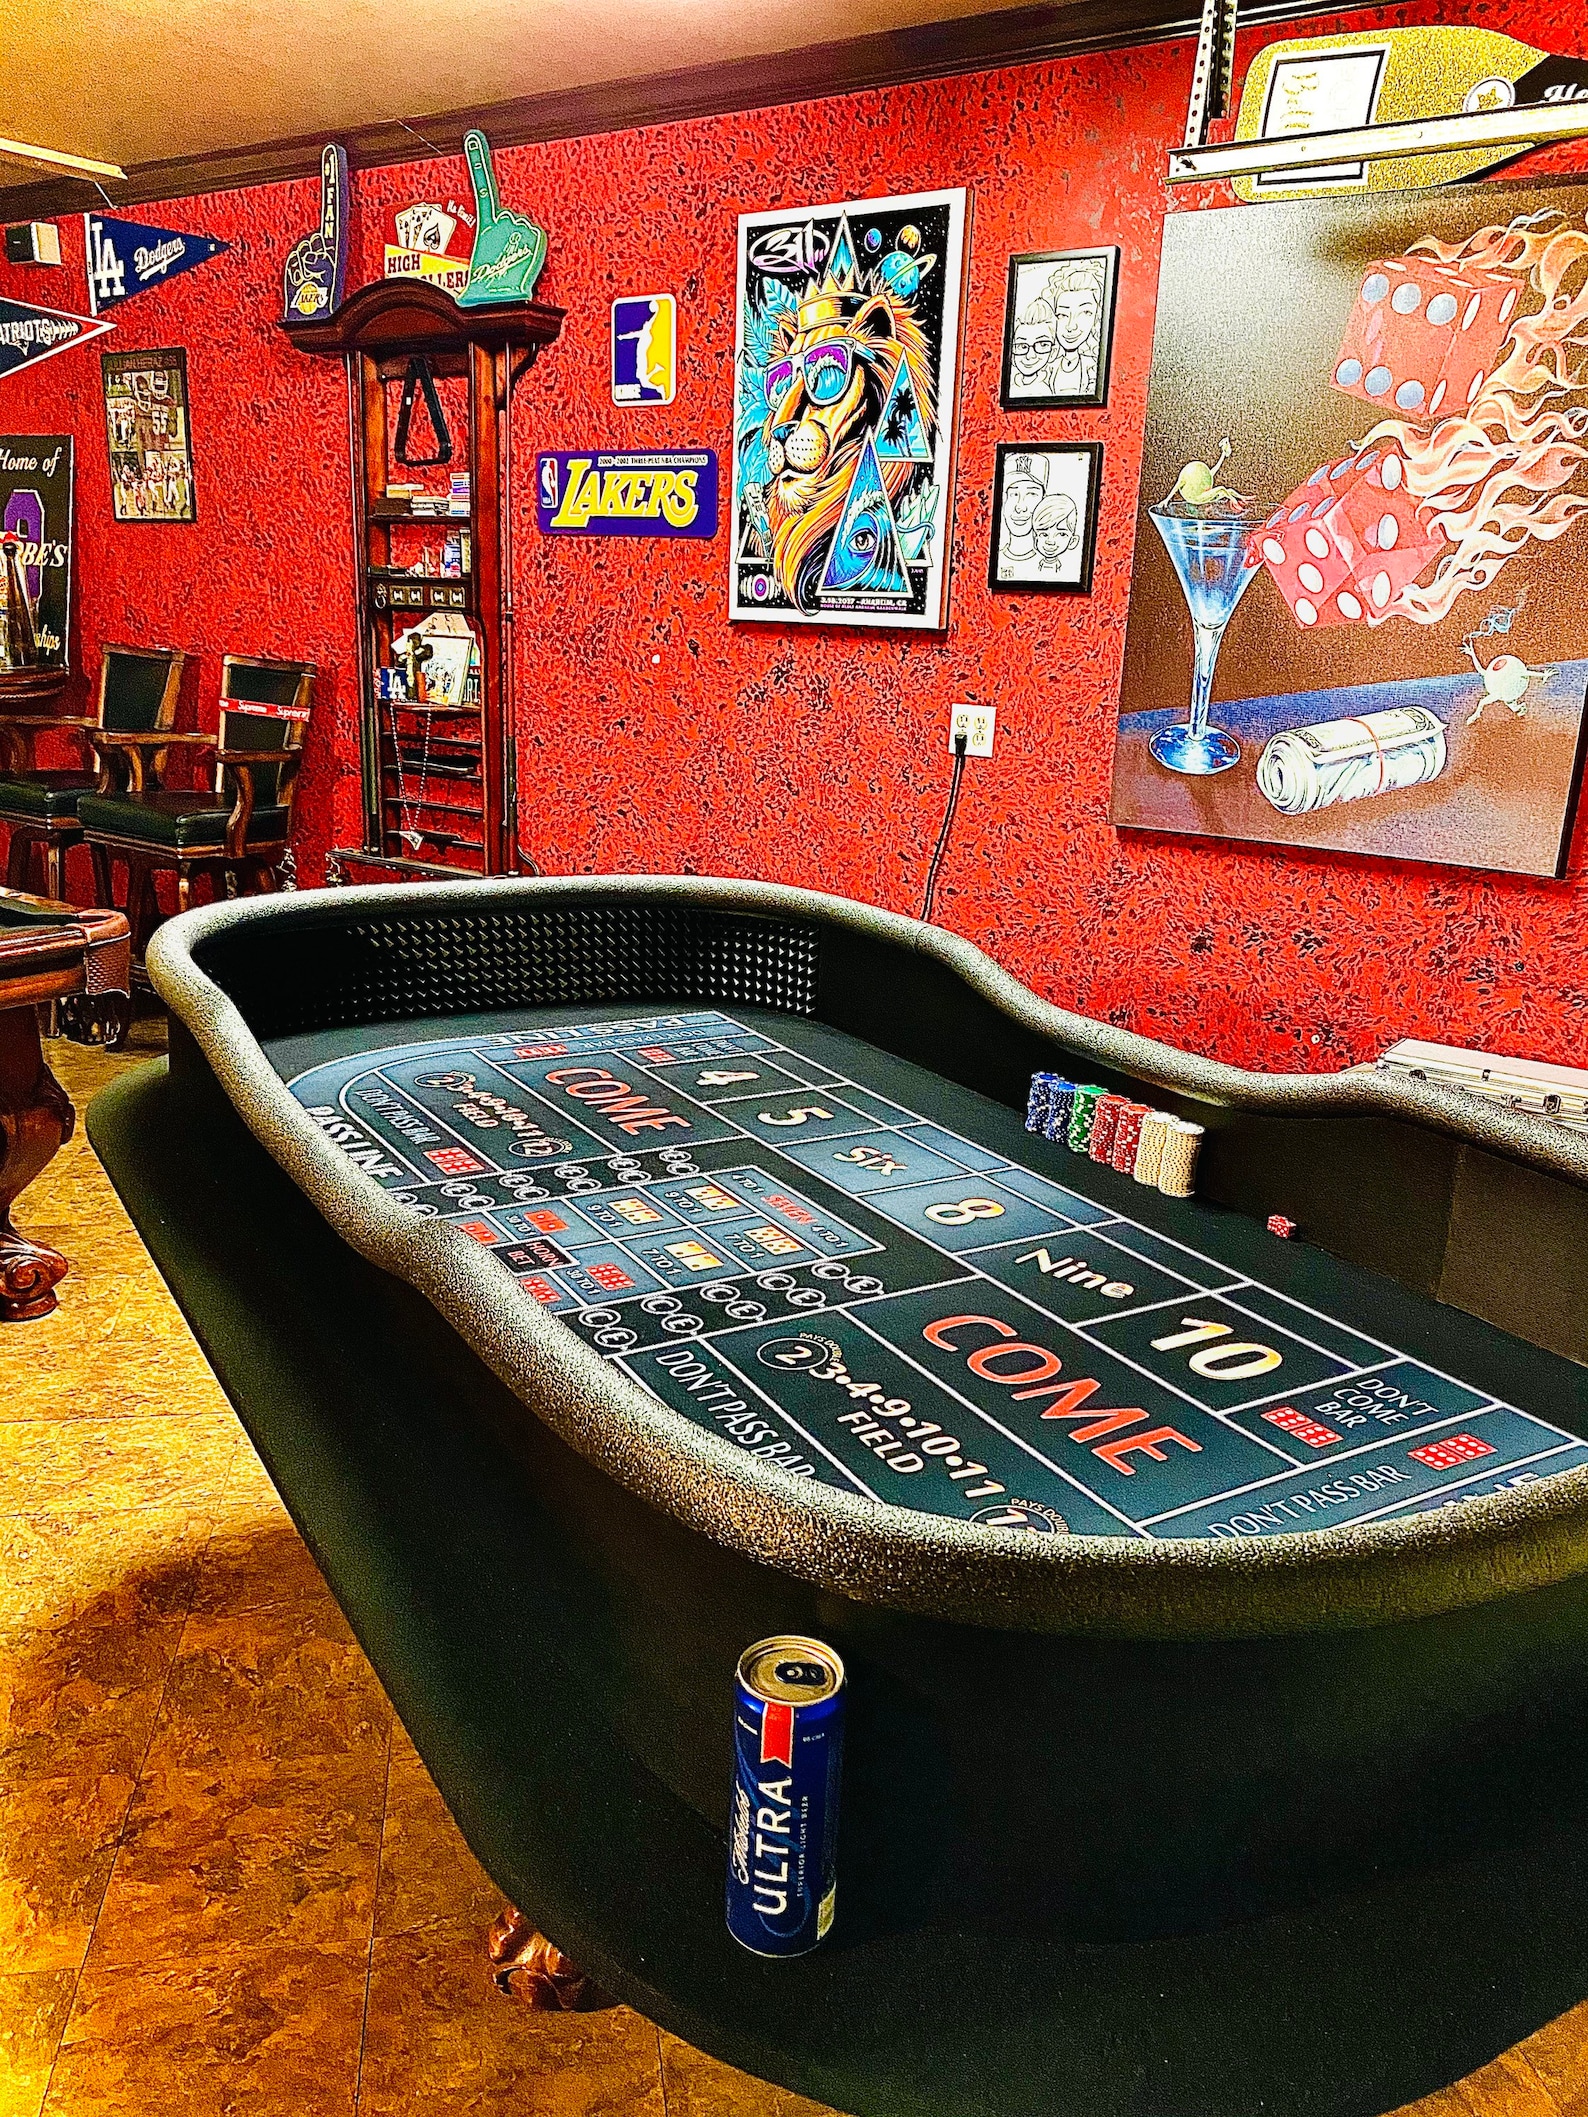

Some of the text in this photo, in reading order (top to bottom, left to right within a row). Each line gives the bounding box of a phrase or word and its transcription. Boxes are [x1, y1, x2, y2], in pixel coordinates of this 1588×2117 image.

[325, 187, 335, 238] FAN
[91, 222, 125, 297] LA
[134, 237, 186, 277] Dodgers
[387, 254, 421, 274] HIGH
[471, 244, 533, 283] Dodgers
[42, 447, 62, 477] of
[550, 459, 699, 528] LAKERS
[486, 1018, 686, 1045] PASS LINE
[696, 1070, 760, 1086] 4
[453, 1102, 499, 1128] FIELD
[545, 1067, 693, 1135] COME
[757, 1106, 834, 1127] 5
[595, 1211, 616, 1223] TO
[672, 1197, 694, 1209] TO
[760, 1194, 820, 1225] SEVEN
[924, 1197, 1006, 1226] 8
[507, 1251, 536, 1266] BET
[526, 1241, 564, 1267] HORN
[733, 1239, 757, 1253] TO
[650, 1254, 674, 1269] TO
[1015, 1247, 1135, 1299] Nine
[799, 1332, 825, 1343] PAYS
[1150, 1317, 1284, 1380] 10
[775, 1346, 812, 1365] 2
[655, 1350, 737, 1401] DON'T
[707, 1400, 779, 1444] PASS
[922, 1314, 1203, 1476] COME
[1332, 1388, 1411, 1426] COME
[1357, 1378, 1440, 1416] DON'T
[1313, 1401, 1369, 1429] BAR
[837, 1411, 924, 1473] FIELD
[1011, 1498, 1046, 1512] PAYS
[1207, 1500, 1301, 1539] DON'T
[1291, 1479, 1361, 1514] PASS
[1349, 1465, 1412, 1492] BAR
[801, 1795, 809, 1820] BEER
[752, 1776, 793, 1916] ULTRA
